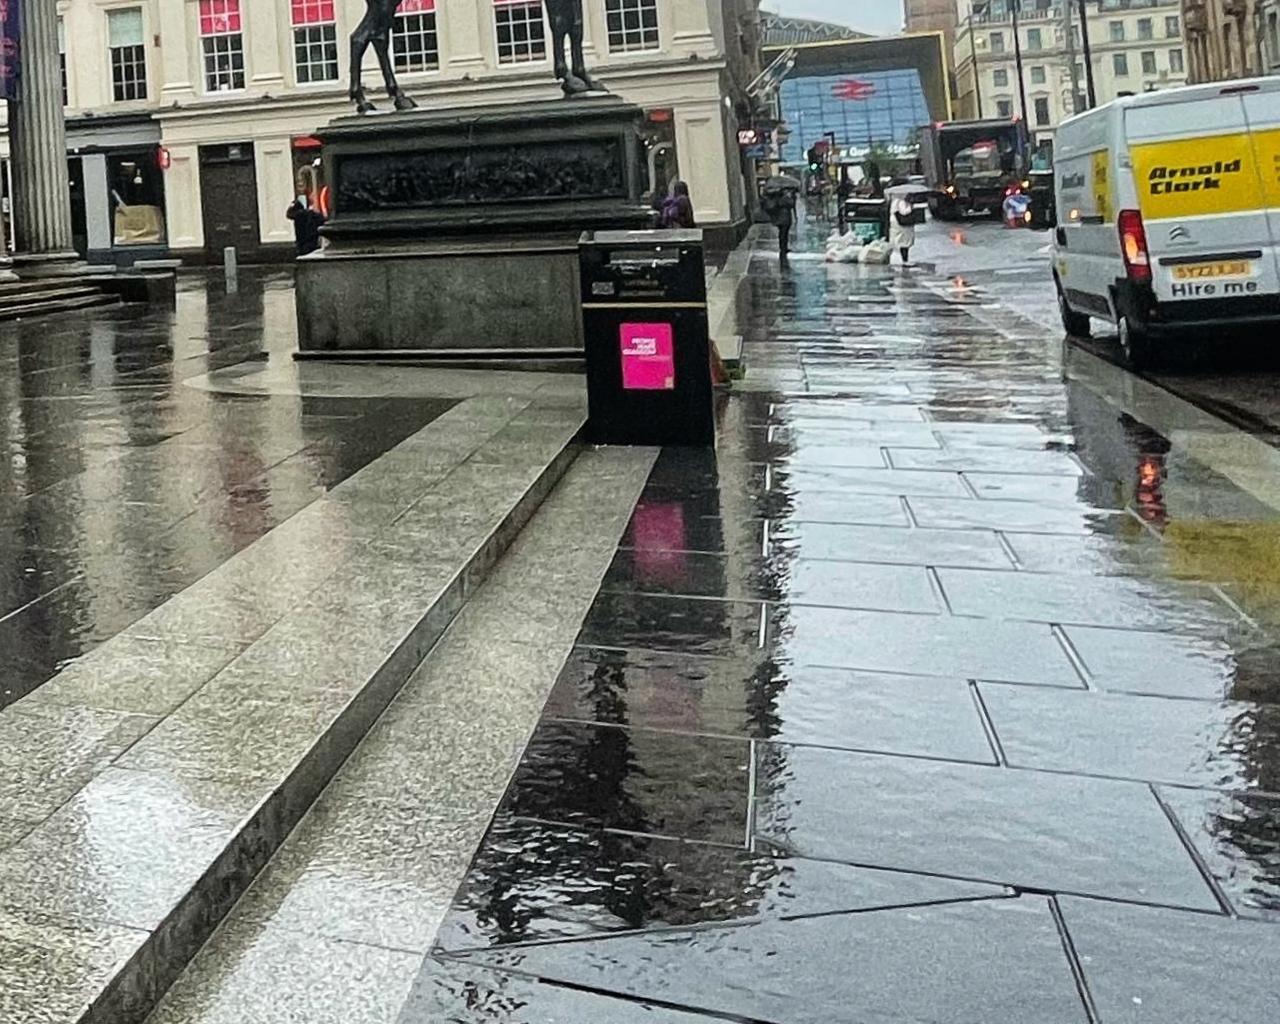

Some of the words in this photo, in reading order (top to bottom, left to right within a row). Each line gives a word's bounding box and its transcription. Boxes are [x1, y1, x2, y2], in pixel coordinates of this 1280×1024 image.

[1149, 159, 1241, 180] Arnold
[1150, 177, 1220, 194] Clark
[1172, 283, 1216, 296] Hire
[1224, 281, 1257, 294] me
